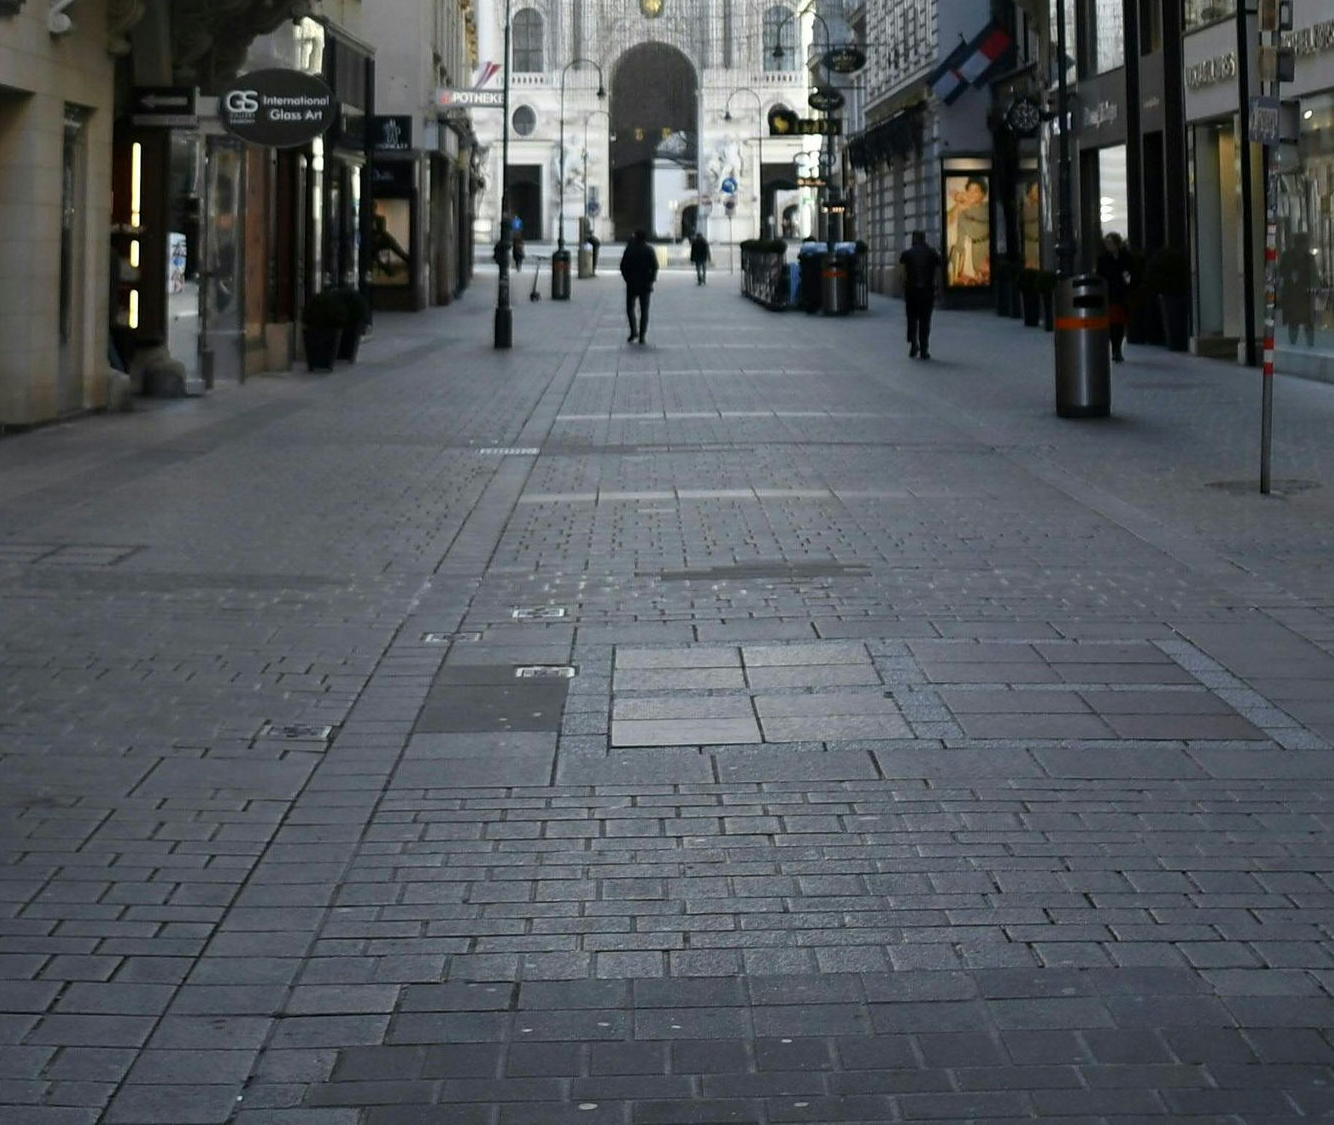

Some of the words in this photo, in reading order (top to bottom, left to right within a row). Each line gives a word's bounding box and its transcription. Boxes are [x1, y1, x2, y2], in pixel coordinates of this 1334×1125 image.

[227, 89, 260, 113] GS
[263, 94, 330, 107] International
[269, 108, 303, 121] Glass
[304, 108, 323, 121] Art
